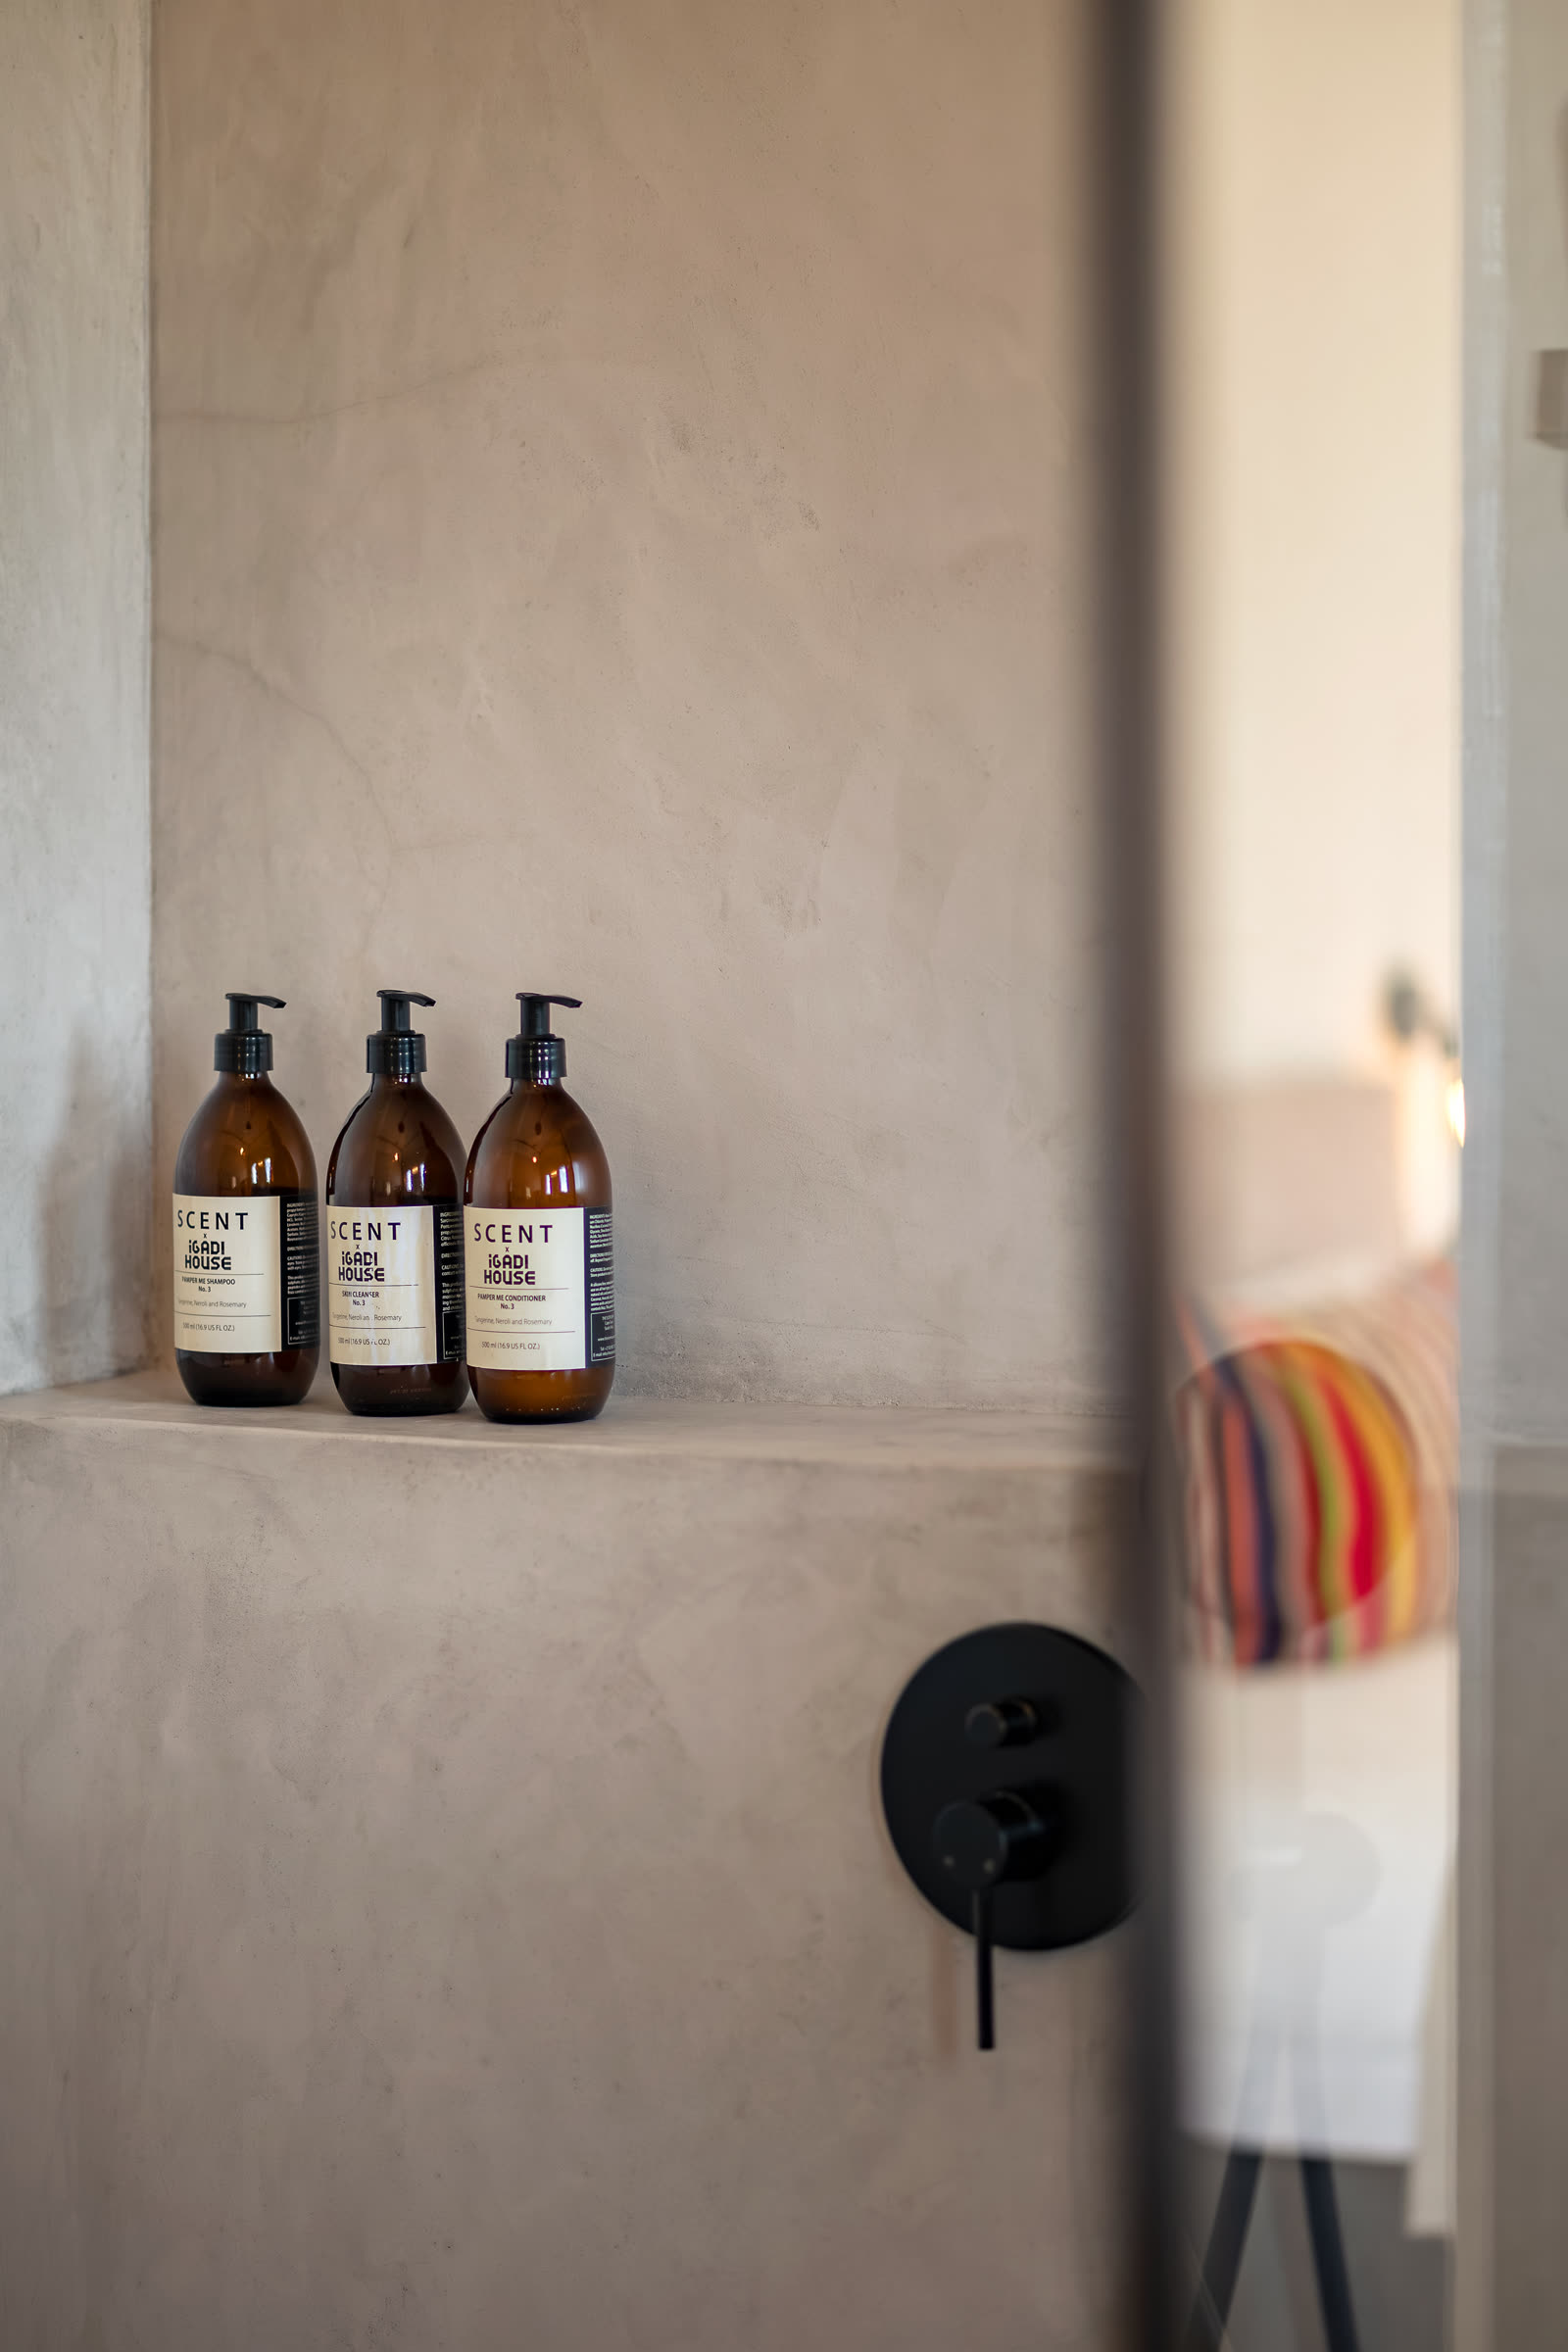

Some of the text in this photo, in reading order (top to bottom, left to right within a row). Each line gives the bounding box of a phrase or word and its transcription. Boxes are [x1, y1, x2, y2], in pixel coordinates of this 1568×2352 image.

[177, 1209, 248, 1230] SCENT
[331, 1221, 401, 1241] SCENT
[474, 1223, 553, 1243] SCENT
[184, 1254, 231, 1270] HOUSE
[338, 1266, 384, 1282] HOUSE
[483, 1269, 535, 1285] HOUSE
